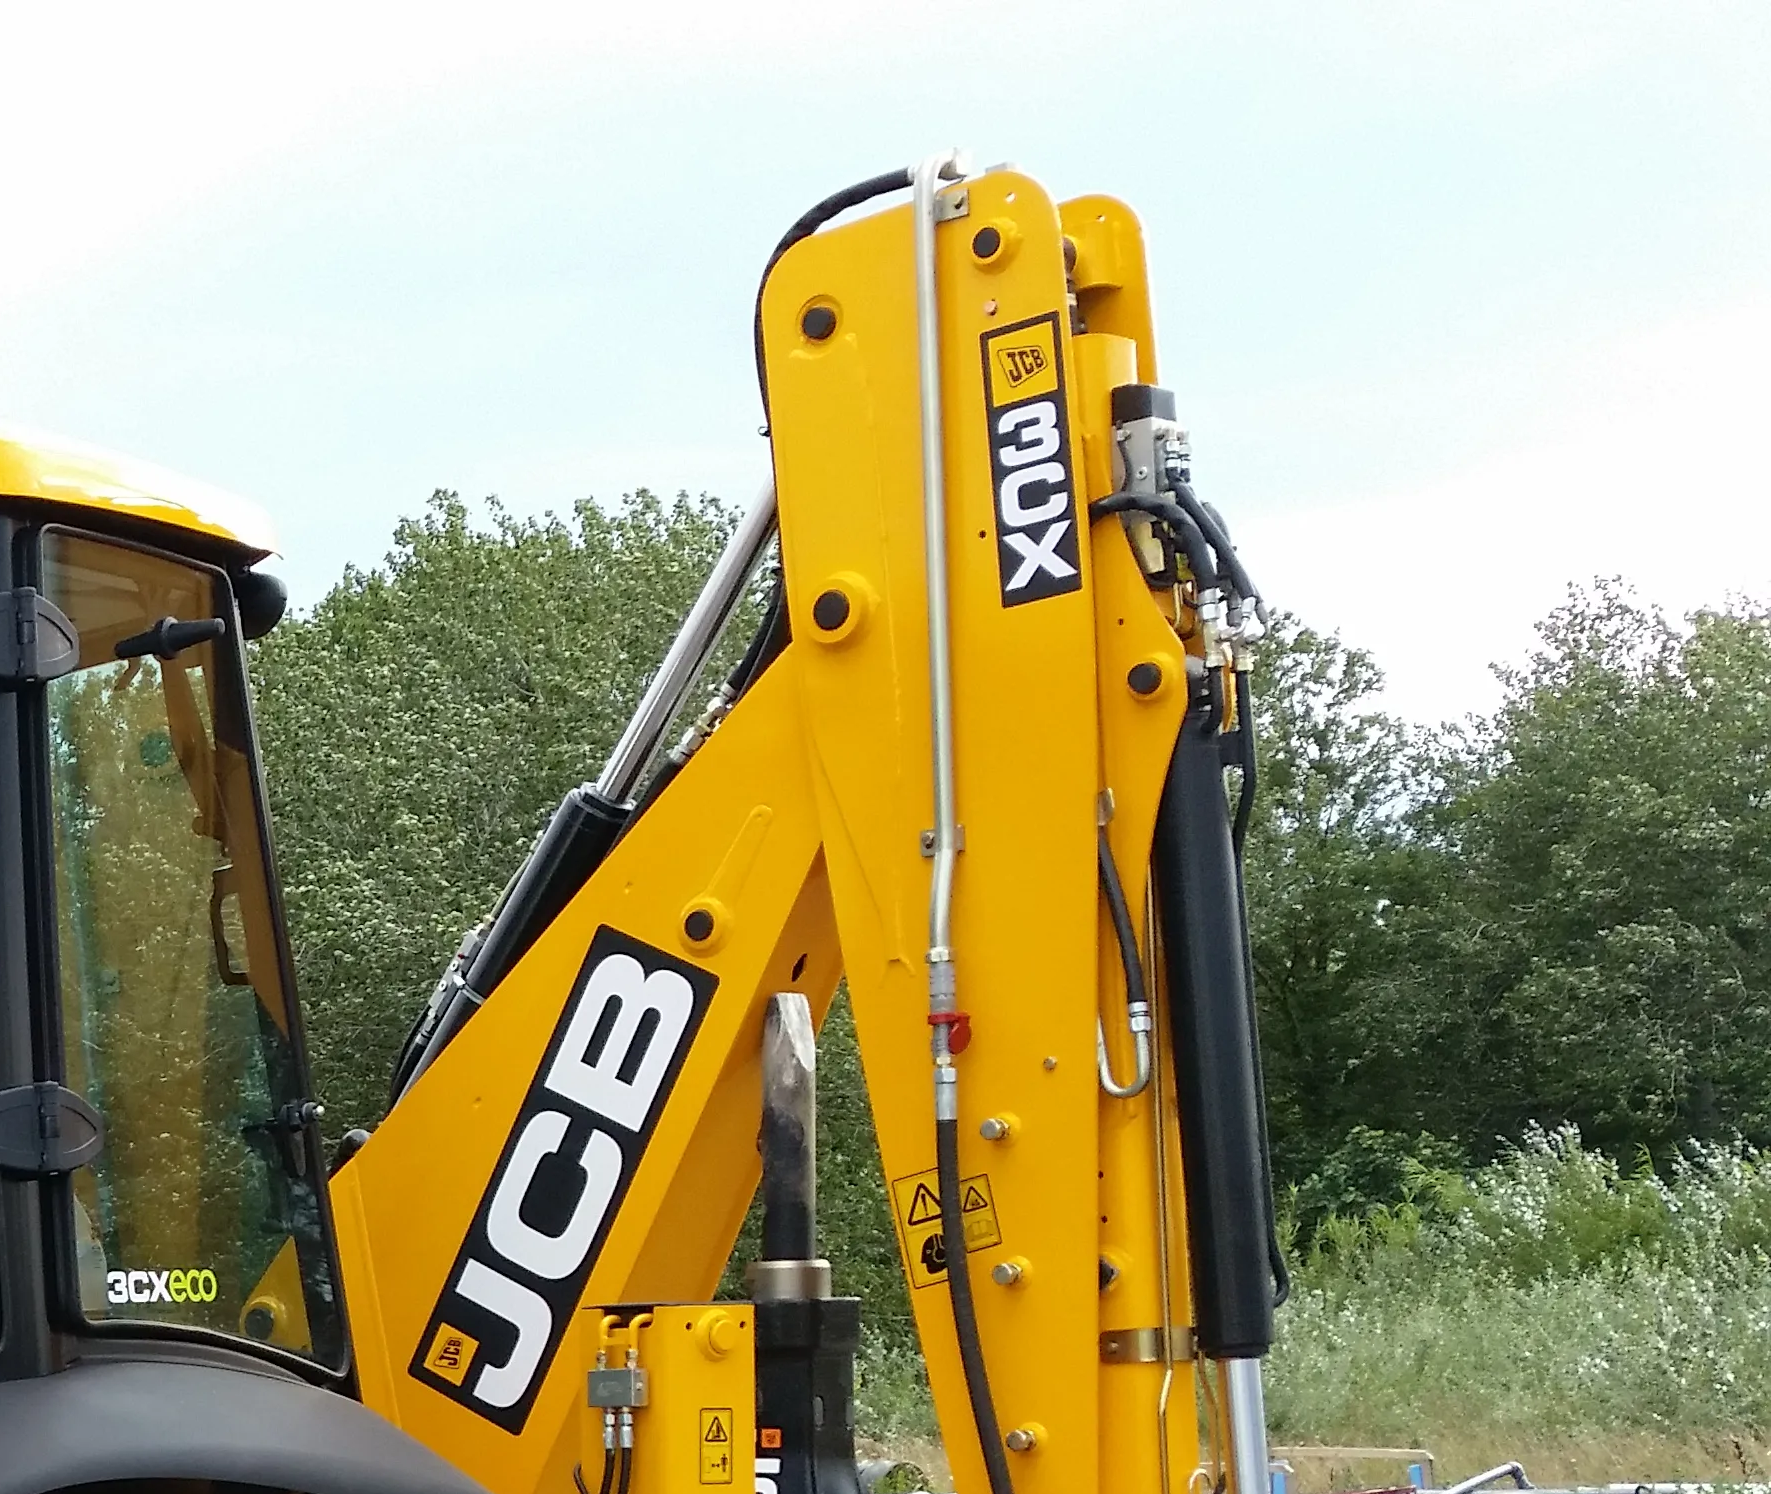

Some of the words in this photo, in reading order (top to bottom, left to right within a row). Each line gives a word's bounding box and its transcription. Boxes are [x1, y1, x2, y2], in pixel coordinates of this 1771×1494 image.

[1007, 349, 1044, 382] JCB
[997, 400, 1079, 591] 3CX
[455, 953, 694, 1408] JCB
[107, 1269, 218, 1304] 3CXeco
[438, 1339, 462, 1366] JCB
